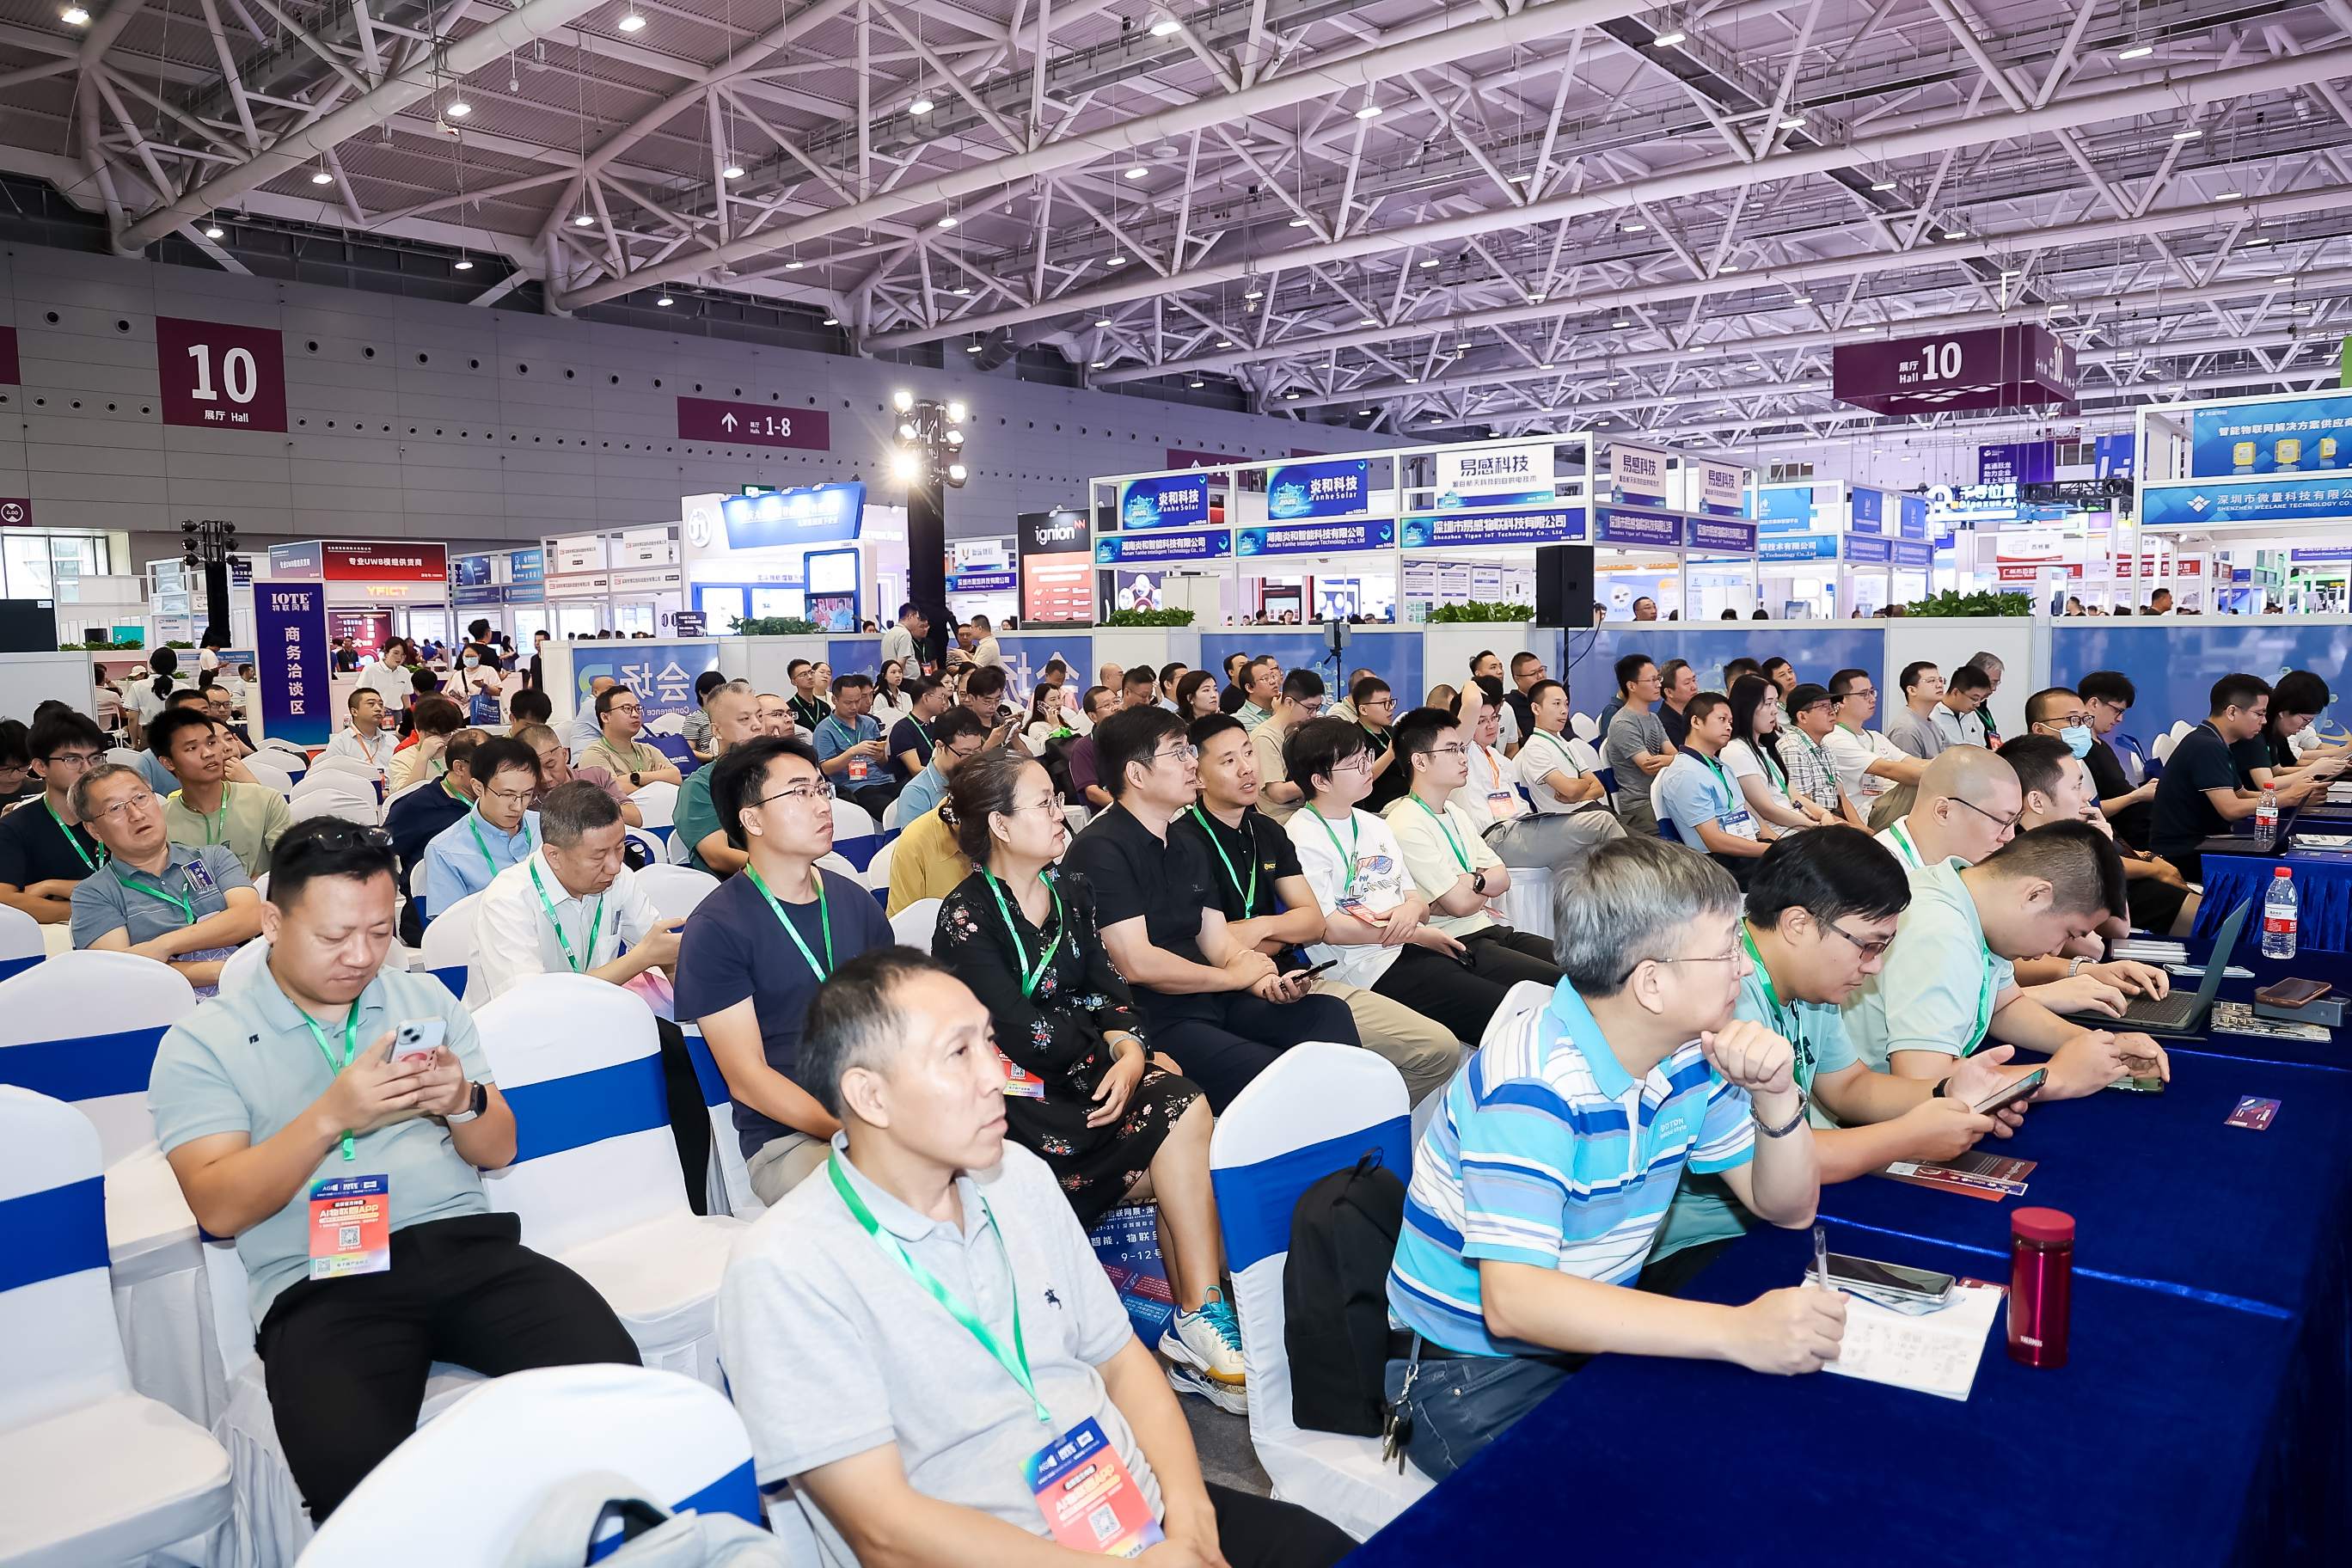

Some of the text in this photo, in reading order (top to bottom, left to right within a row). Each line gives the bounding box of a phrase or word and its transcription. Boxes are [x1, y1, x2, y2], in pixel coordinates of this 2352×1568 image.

[1899, 360, 1919, 372] 展厅
[1922, 341, 1963, 381] 10
[187, 344, 257, 403] 10
[1899, 372, 1919, 384] Hall
[205, 409, 248, 422] 展厅 Hall
[766, 416, 791, 437] 1-8
[2218, 417, 2352, 437] 智能物联网解决方案供应商
[1461, 454, 1529, 476] 易感科技
[1623, 454, 1657, 476] 易感科技
[1310, 475, 1357, 494] 炎和科技
[1708, 469, 1735, 489] 易感科技
[1158, 488, 1199, 506] 炎和科技
[2217, 487, 2352, 505] 深圳市微量科技有限公
[1433, 514, 1567, 534] 深圳市易感物联科技有限公司
[1034, 524, 1075, 546] ignion
[1266, 526, 1365, 542] 湖南炎和智能科技有限公司
[1121, 537, 1206, 551] 湖南炎和智能科技有限公司
[348, 557, 422, 567] 专业UWB模组供货商
[272, 593, 309, 604] IOTE
[285, 626, 305, 715] 商务洽谈区
[2020, 1333, 2043, 1347] THERMOS
